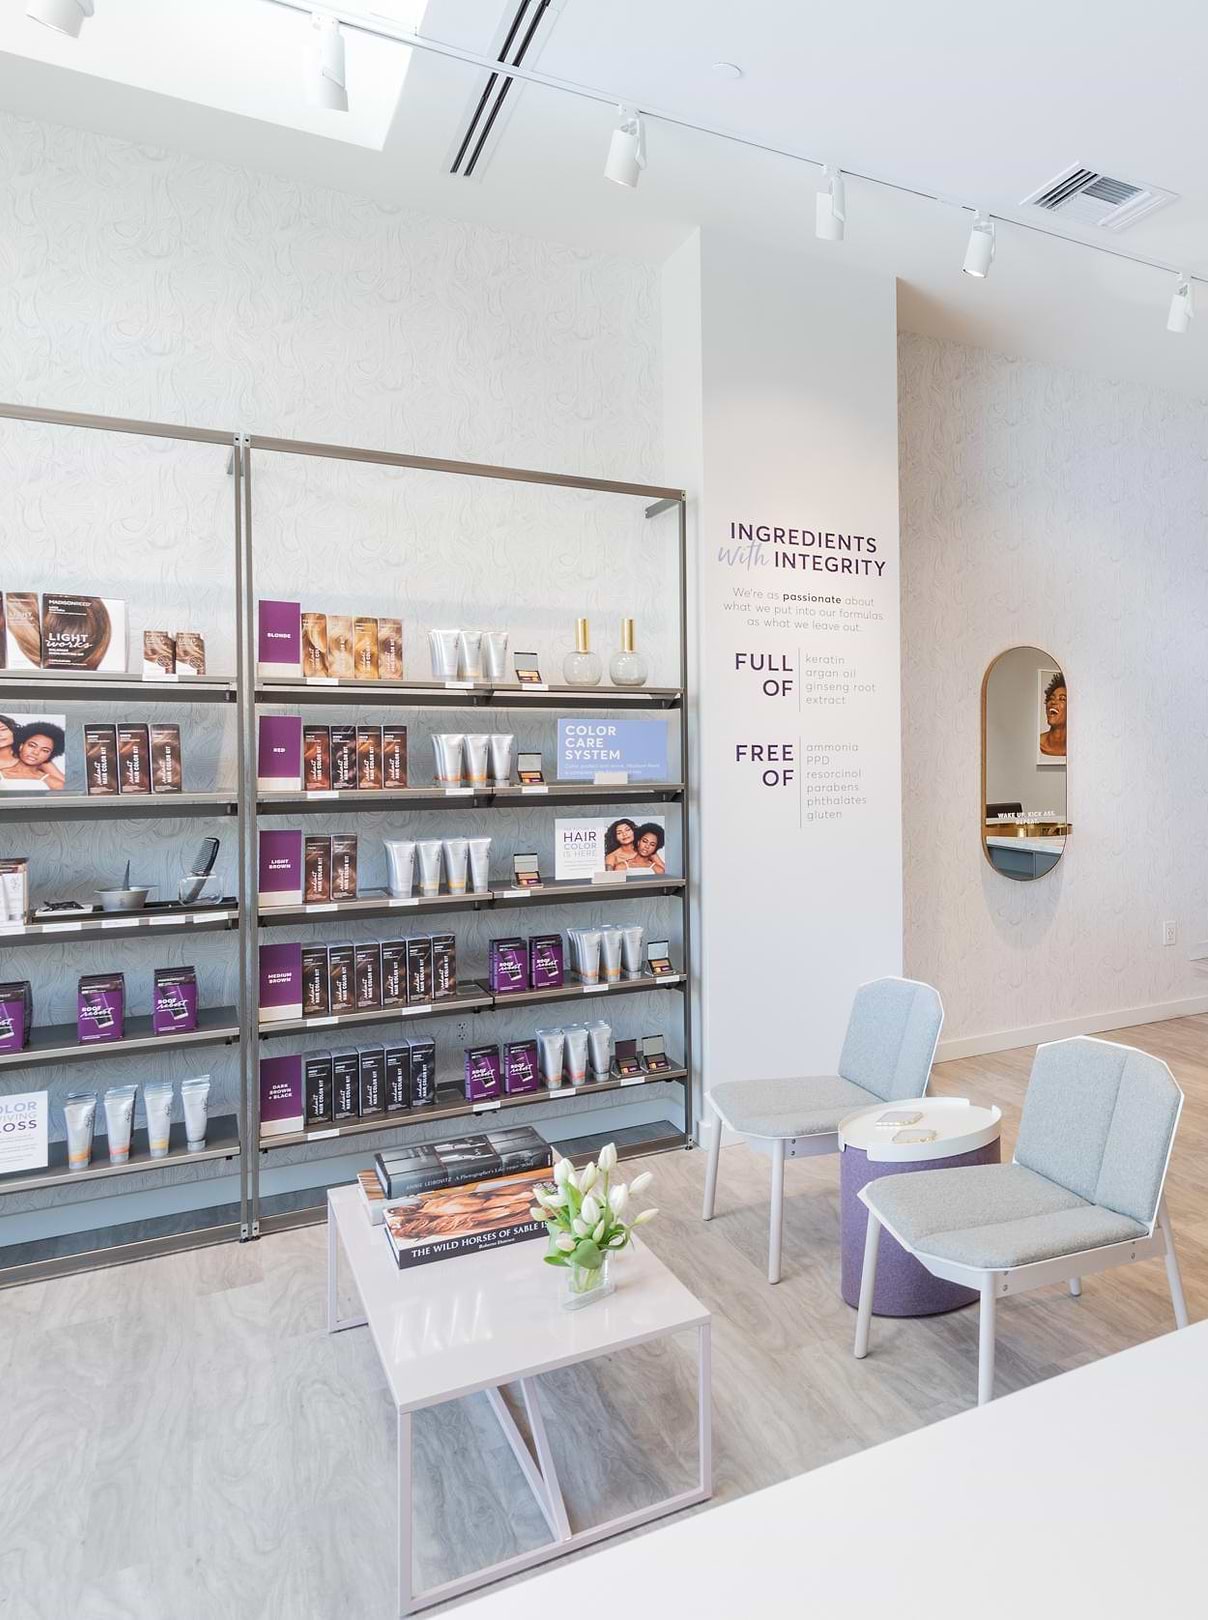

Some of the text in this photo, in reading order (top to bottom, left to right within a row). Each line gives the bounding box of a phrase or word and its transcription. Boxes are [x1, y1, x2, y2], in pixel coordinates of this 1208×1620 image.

[730, 521, 877, 553] INGREDIENTS
[717, 541, 886, 577] with INTEGRITY
[732, 587, 874, 607] We're as passionate about
[723, 601, 883, 621] what we put into our formulas
[747, 616, 862, 633] as what we leave out.
[45, 639, 93, 648] works
[49, 633, 88, 642] LIGHT
[735, 653, 793, 672] FULL
[805, 654, 845, 665] keratin
[806, 668, 856, 680] argan oil
[762, 680, 793, 697] OF
[806, 682, 876, 694] ginseng root
[806, 695, 846, 705] extract
[565, 725, 616, 736] COLOR
[565, 738, 604, 748] CARE
[806, 743, 859, 752] ammonia
[565, 750, 620, 760] SYSTEM
[735, 745, 794, 762] FREE
[807, 756, 830, 766] PPD
[762, 770, 794, 787] OF
[807, 768, 861, 779] resorcinol
[807, 782, 859, 793] parabens
[807, 795, 867, 807] phthalates
[807, 809, 842, 822] gluten
[563, 832, 597, 842] HAIR
[0, 1101, 37, 1114] LOR
[0, 1119, 37, 1133] OSS
[411, 1247, 431, 1258] THE
[433, 1241, 459, 1253] WILD
[461, 1233, 497, 1247] HORSES
[499, 1228, 511, 1238] OF
[513, 1223, 539, 1235] SABLE
